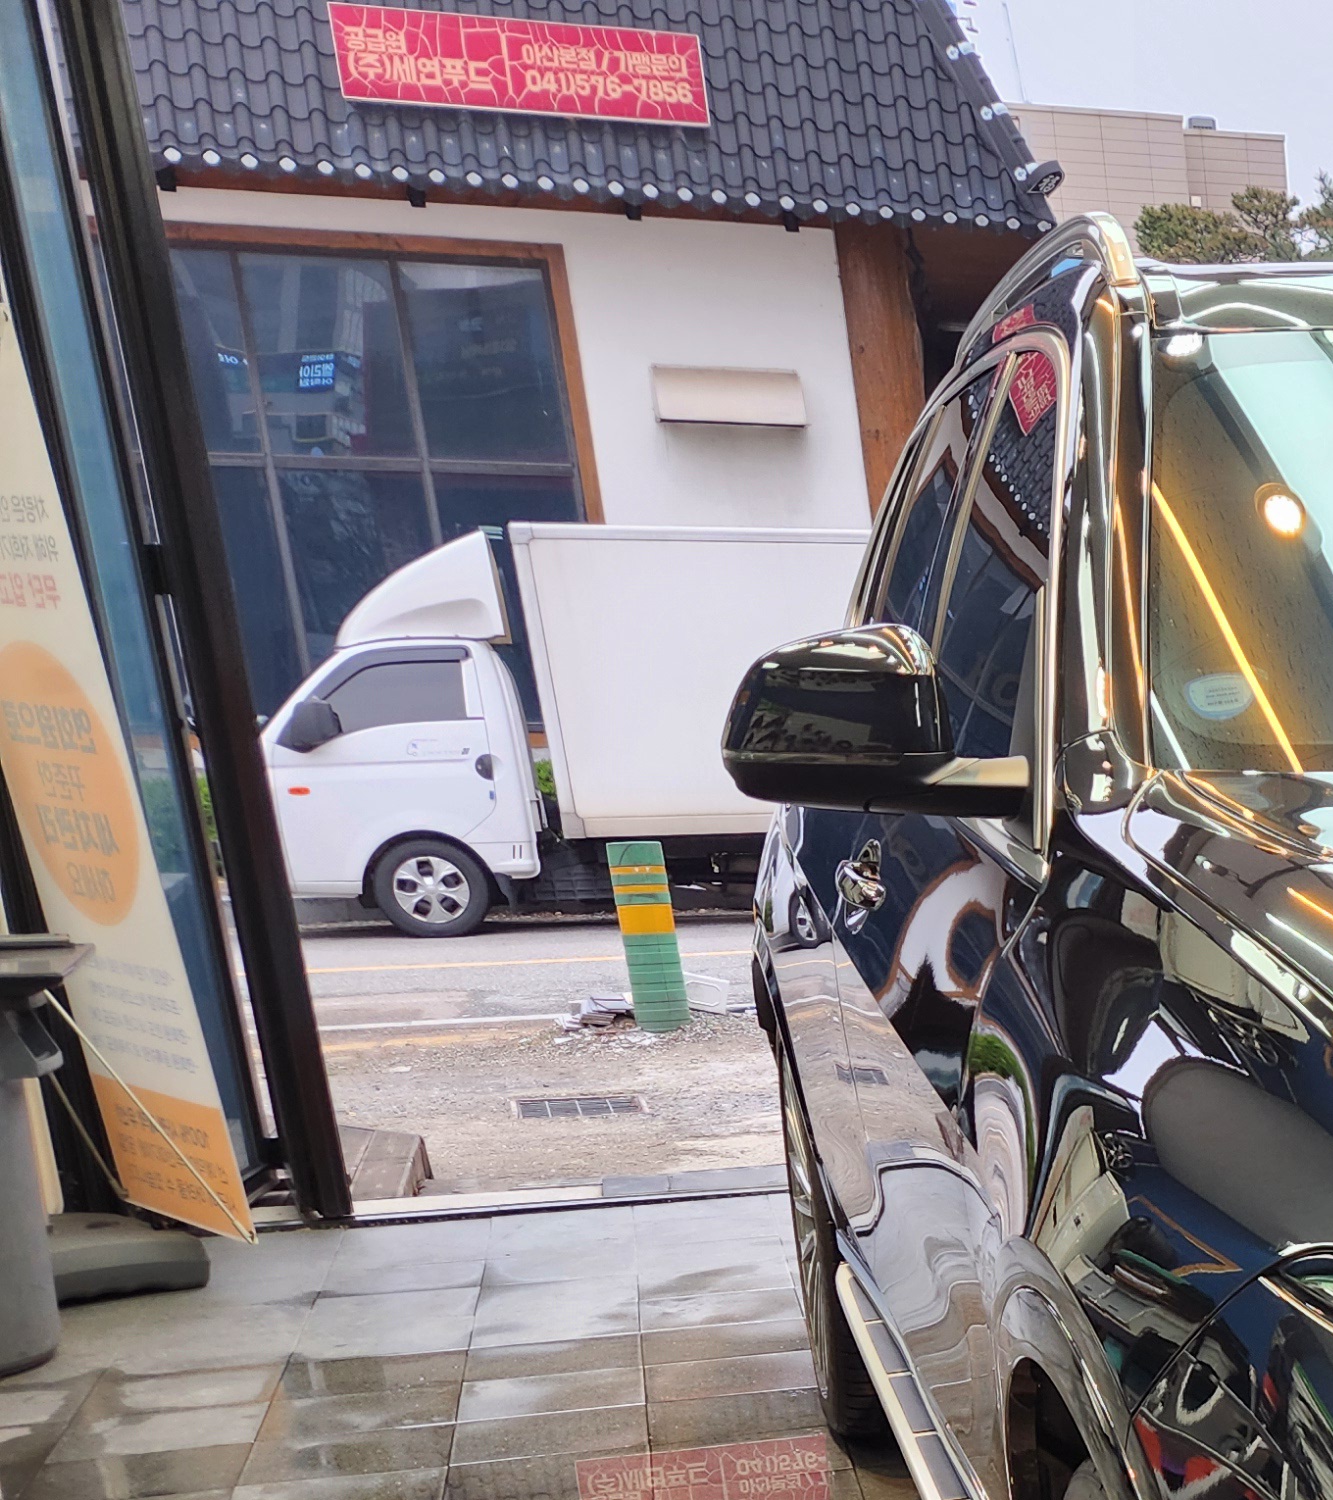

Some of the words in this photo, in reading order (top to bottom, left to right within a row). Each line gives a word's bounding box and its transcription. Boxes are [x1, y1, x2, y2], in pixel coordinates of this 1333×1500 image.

[344, 26, 405, 54] 공급원
[350, 51, 493, 90] (주)세연푸드
[521, 43, 597, 70] 아산본점
[616, 51, 688, 78] 가맹문의
[526, 69, 694, 103] 041)576-7856
